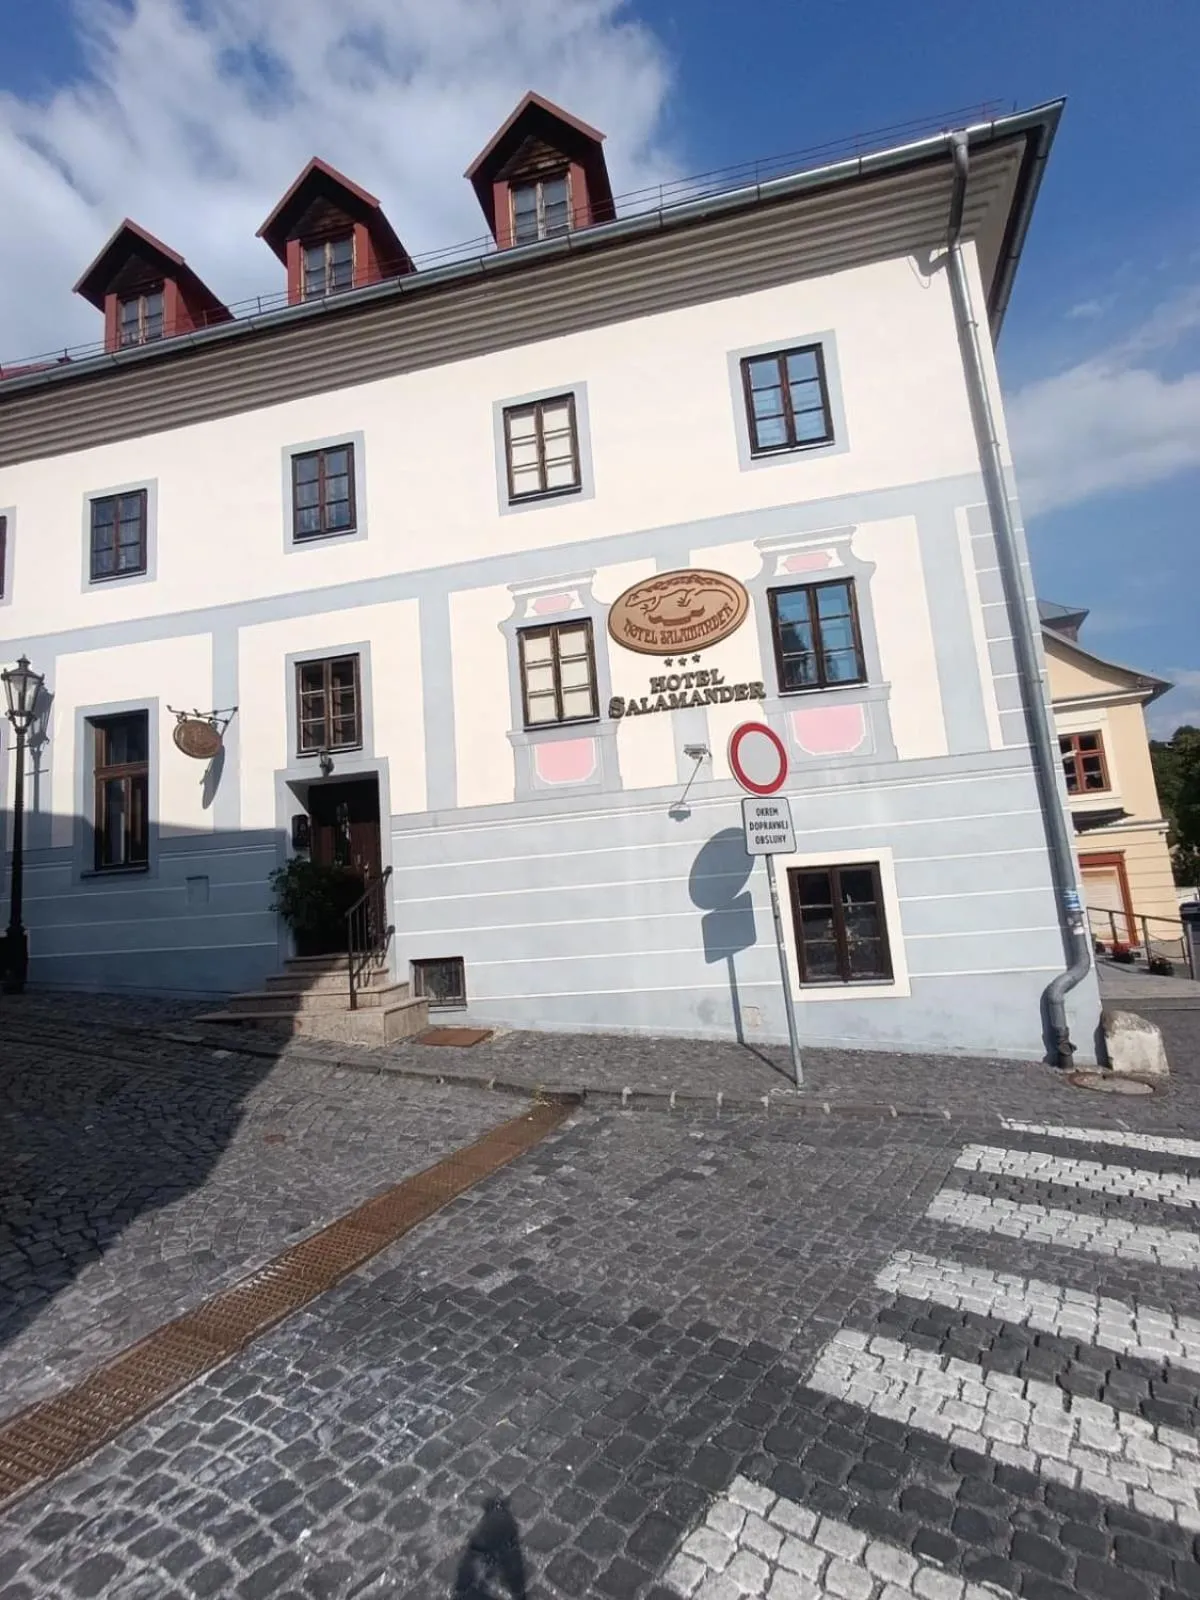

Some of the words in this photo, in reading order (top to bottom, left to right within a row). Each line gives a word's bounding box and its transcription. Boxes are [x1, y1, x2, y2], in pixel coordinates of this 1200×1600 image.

[649, 668, 725, 695] HOTEL
[608, 681, 767, 719] SALAMANDER
[755, 807, 779, 817] OKREM
[749, 820, 789, 831] DOPRAVNEJ
[755, 834, 786, 845] OBSLUHY
